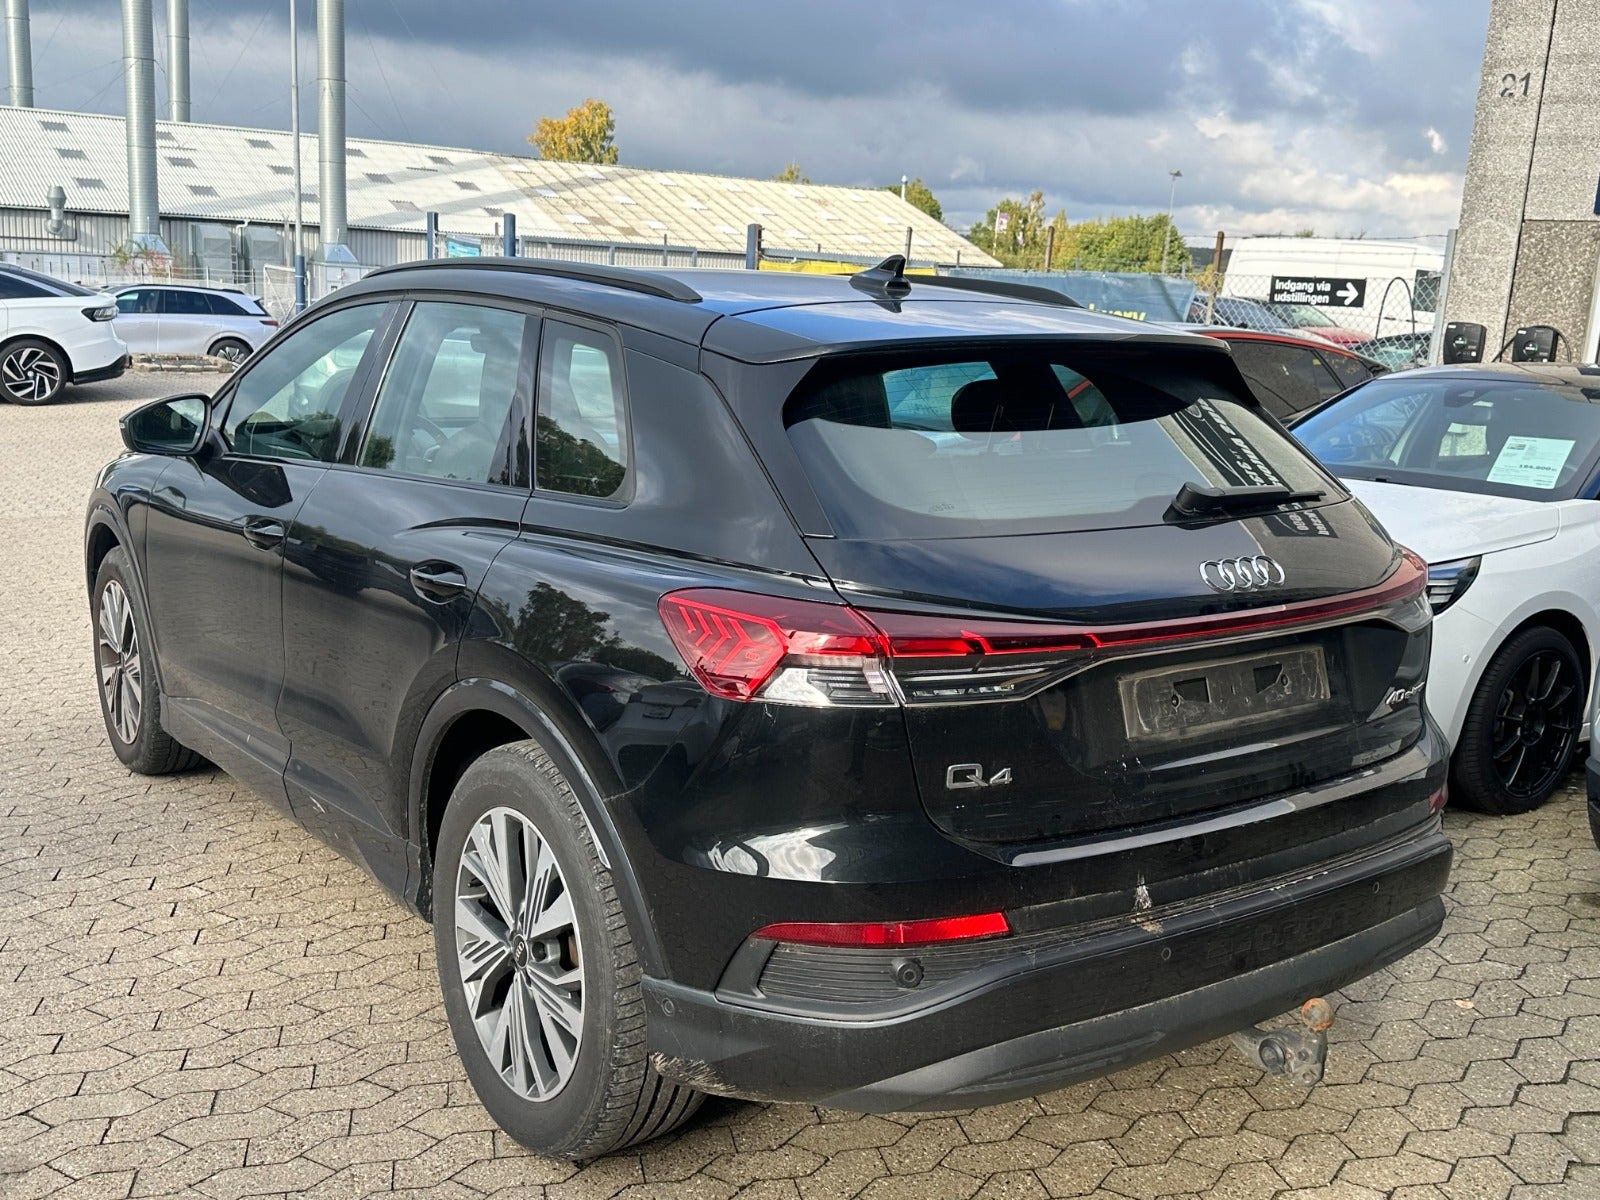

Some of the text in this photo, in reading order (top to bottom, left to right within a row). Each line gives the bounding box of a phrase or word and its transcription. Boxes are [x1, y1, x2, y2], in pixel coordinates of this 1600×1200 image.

[1500, 72, 1531, 97] 21
[1275, 279, 1331, 293] Indgang via
[1273, 292, 1330, 305] udstillingen
[946, 763, 1013, 790] Q4
